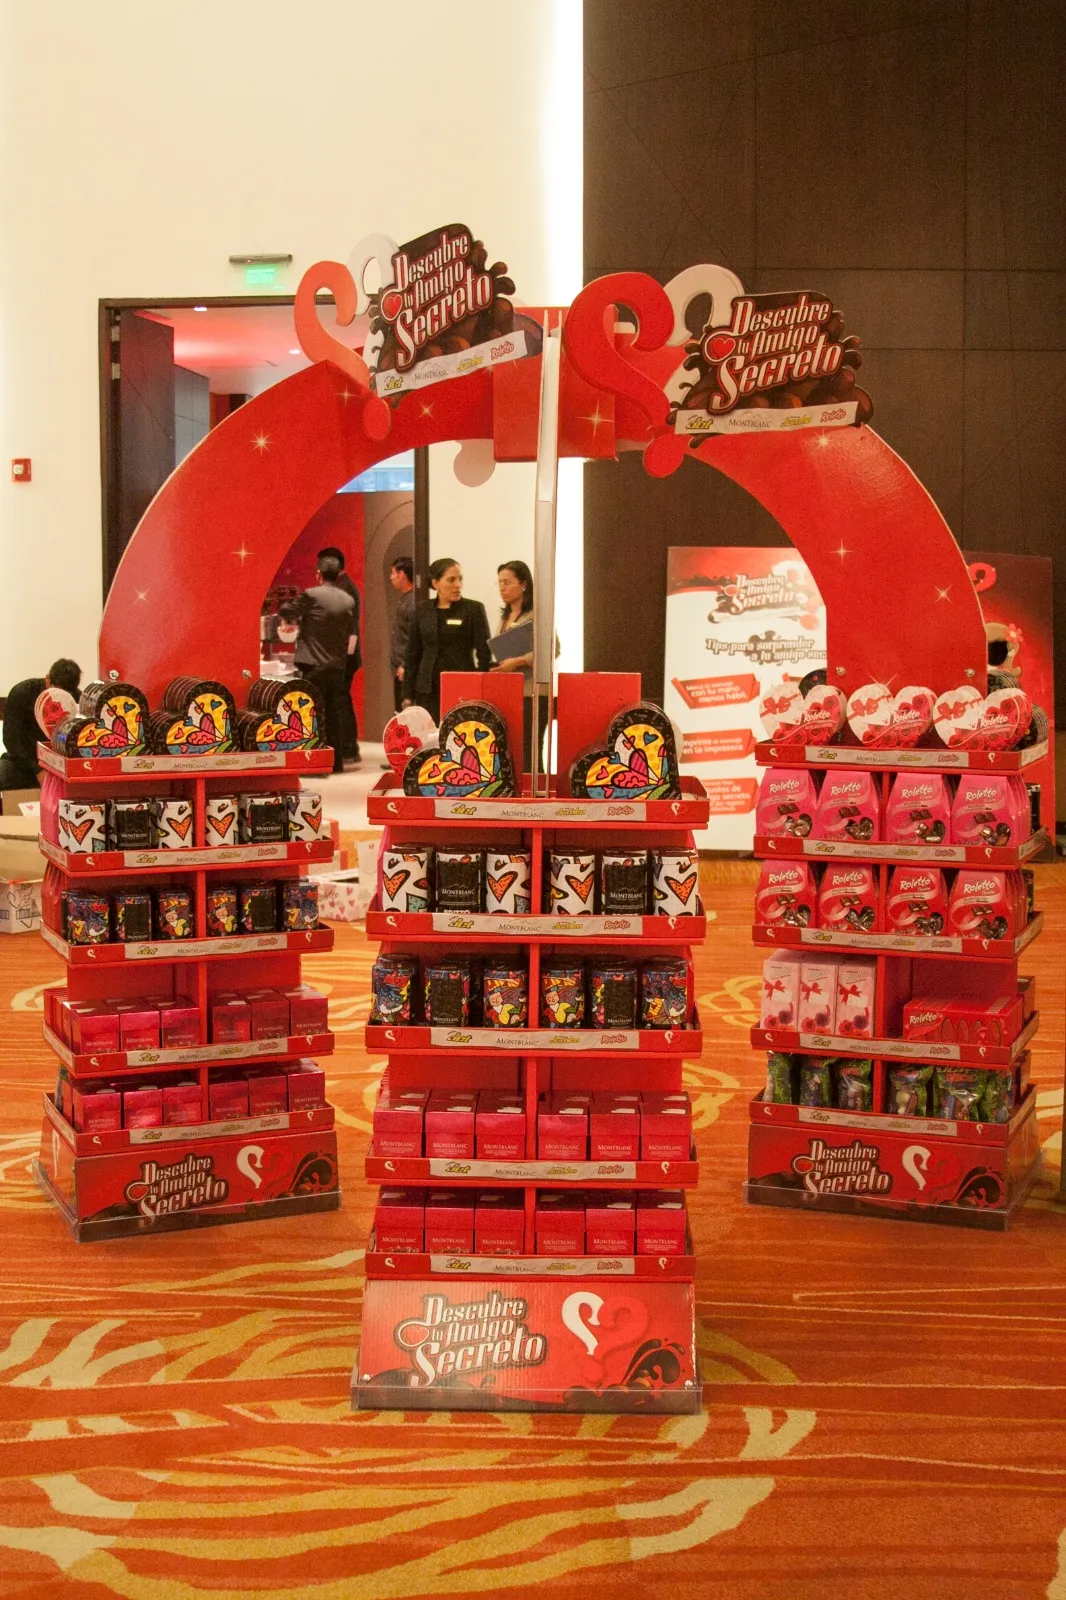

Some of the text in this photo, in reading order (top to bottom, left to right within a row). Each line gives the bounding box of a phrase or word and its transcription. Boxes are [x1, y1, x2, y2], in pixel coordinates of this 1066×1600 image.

[394, 233, 468, 291] Descubre
[403, 260, 464, 312] tu Amigo
[396, 267, 491, 365] Secreto
[733, 296, 829, 335] Descubre
[738, 325, 818, 360] tu Amigo
[414, 369, 450, 381] MONTBLANC
[711, 335, 841, 410] Secreto
[729, 418, 772, 428] MONTBLANC
[706, 639, 729, 655] Tips
[729, 642, 755, 656] para
[804, 709, 831, 723] Roletto
[893, 709, 920, 723] Roletto
[980, 715, 1008, 727] Roletto
[769, 779, 800, 793] Roletto
[831, 782, 861, 796] Roletto
[902, 784, 933, 799] Roletto
[966, 787, 997, 801] Roletto
[501, 809, 543, 818] MONTBLANC
[768, 870, 798, 884] Roletto
[832, 871, 863, 885] Roletto
[900, 876, 931, 890] Roletto
[964, 879, 996, 894] Roletto
[499, 924, 541, 932] MONTBLANC
[909, 1012, 937, 1024] Roletto
[497, 1038, 539, 1047] MONTBLANC
[810, 1140, 877, 1161] Descubre
[143, 1155, 211, 1184] Descubre
[495, 1168, 536, 1177] MONTBLANC
[825, 1159, 870, 1175] Amigo
[160, 1171, 205, 1197] Amigo
[803, 1166, 890, 1200] Secreto
[139, 1176, 226, 1228] Secreto
[424, 1294, 523, 1327] Descubre
[432, 1319, 514, 1347] tu Amigo
[410, 1327, 543, 1387] Secreto
